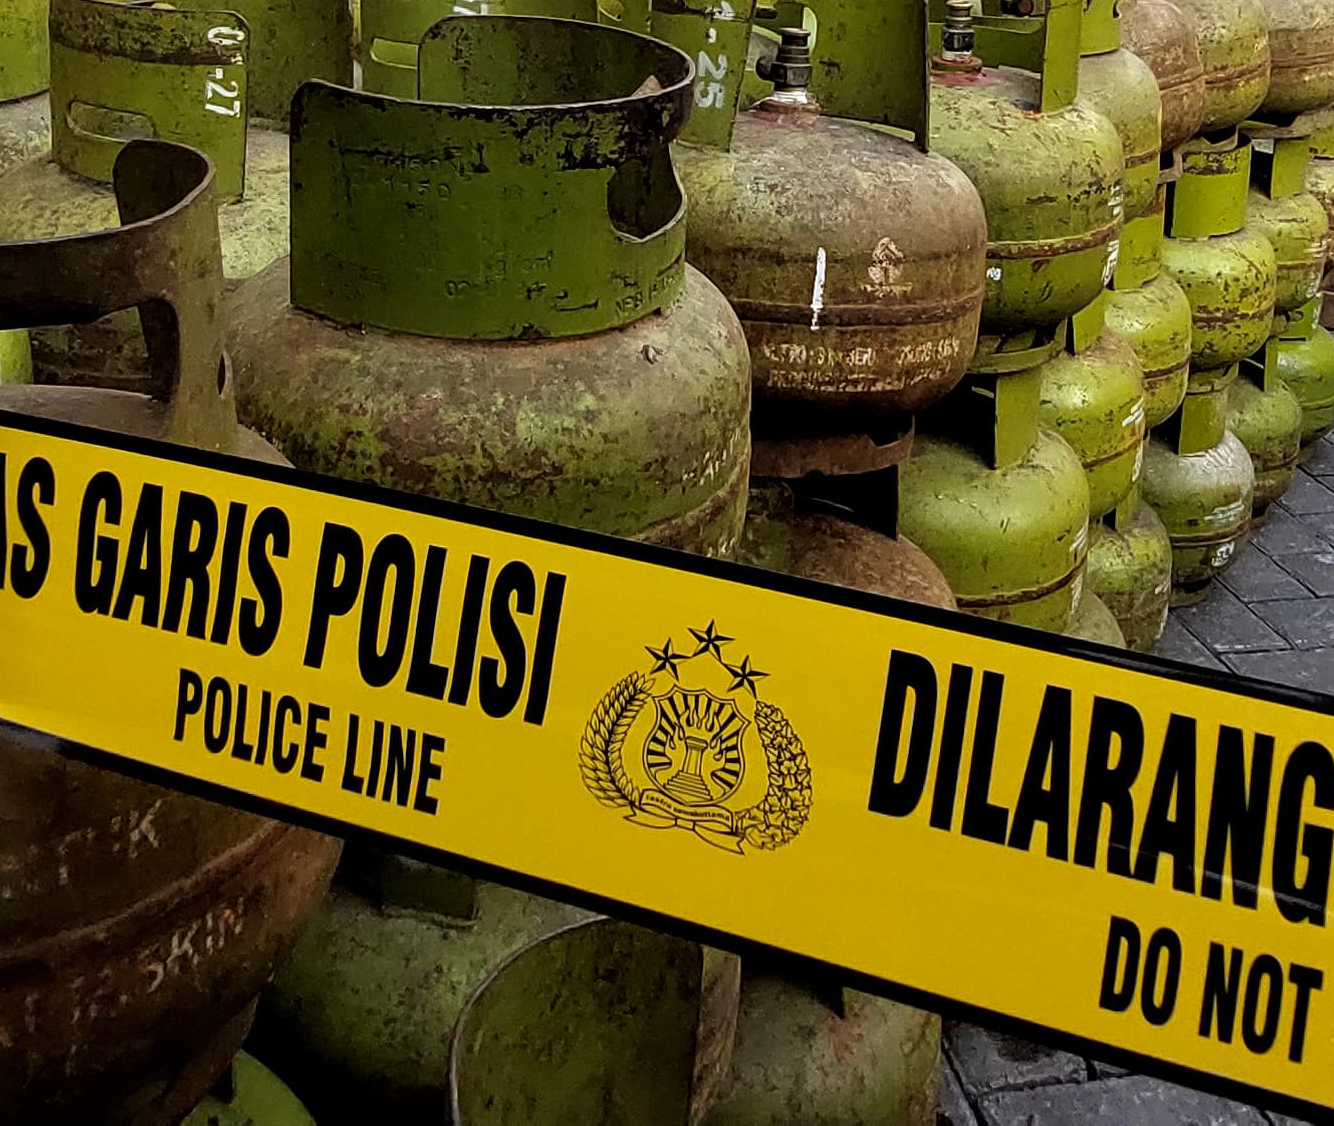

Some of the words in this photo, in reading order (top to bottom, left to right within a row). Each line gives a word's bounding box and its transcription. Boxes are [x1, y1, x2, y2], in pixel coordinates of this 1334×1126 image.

[75, 470, 291, 657] GARIS
[304, 521, 567, 726] POLISI
[173, 668, 332, 782] POLICE
[345, 712, 446, 816] LINE
[1099, 914, 1183, 1027] DO
[1198, 942, 1324, 1064] NOT
